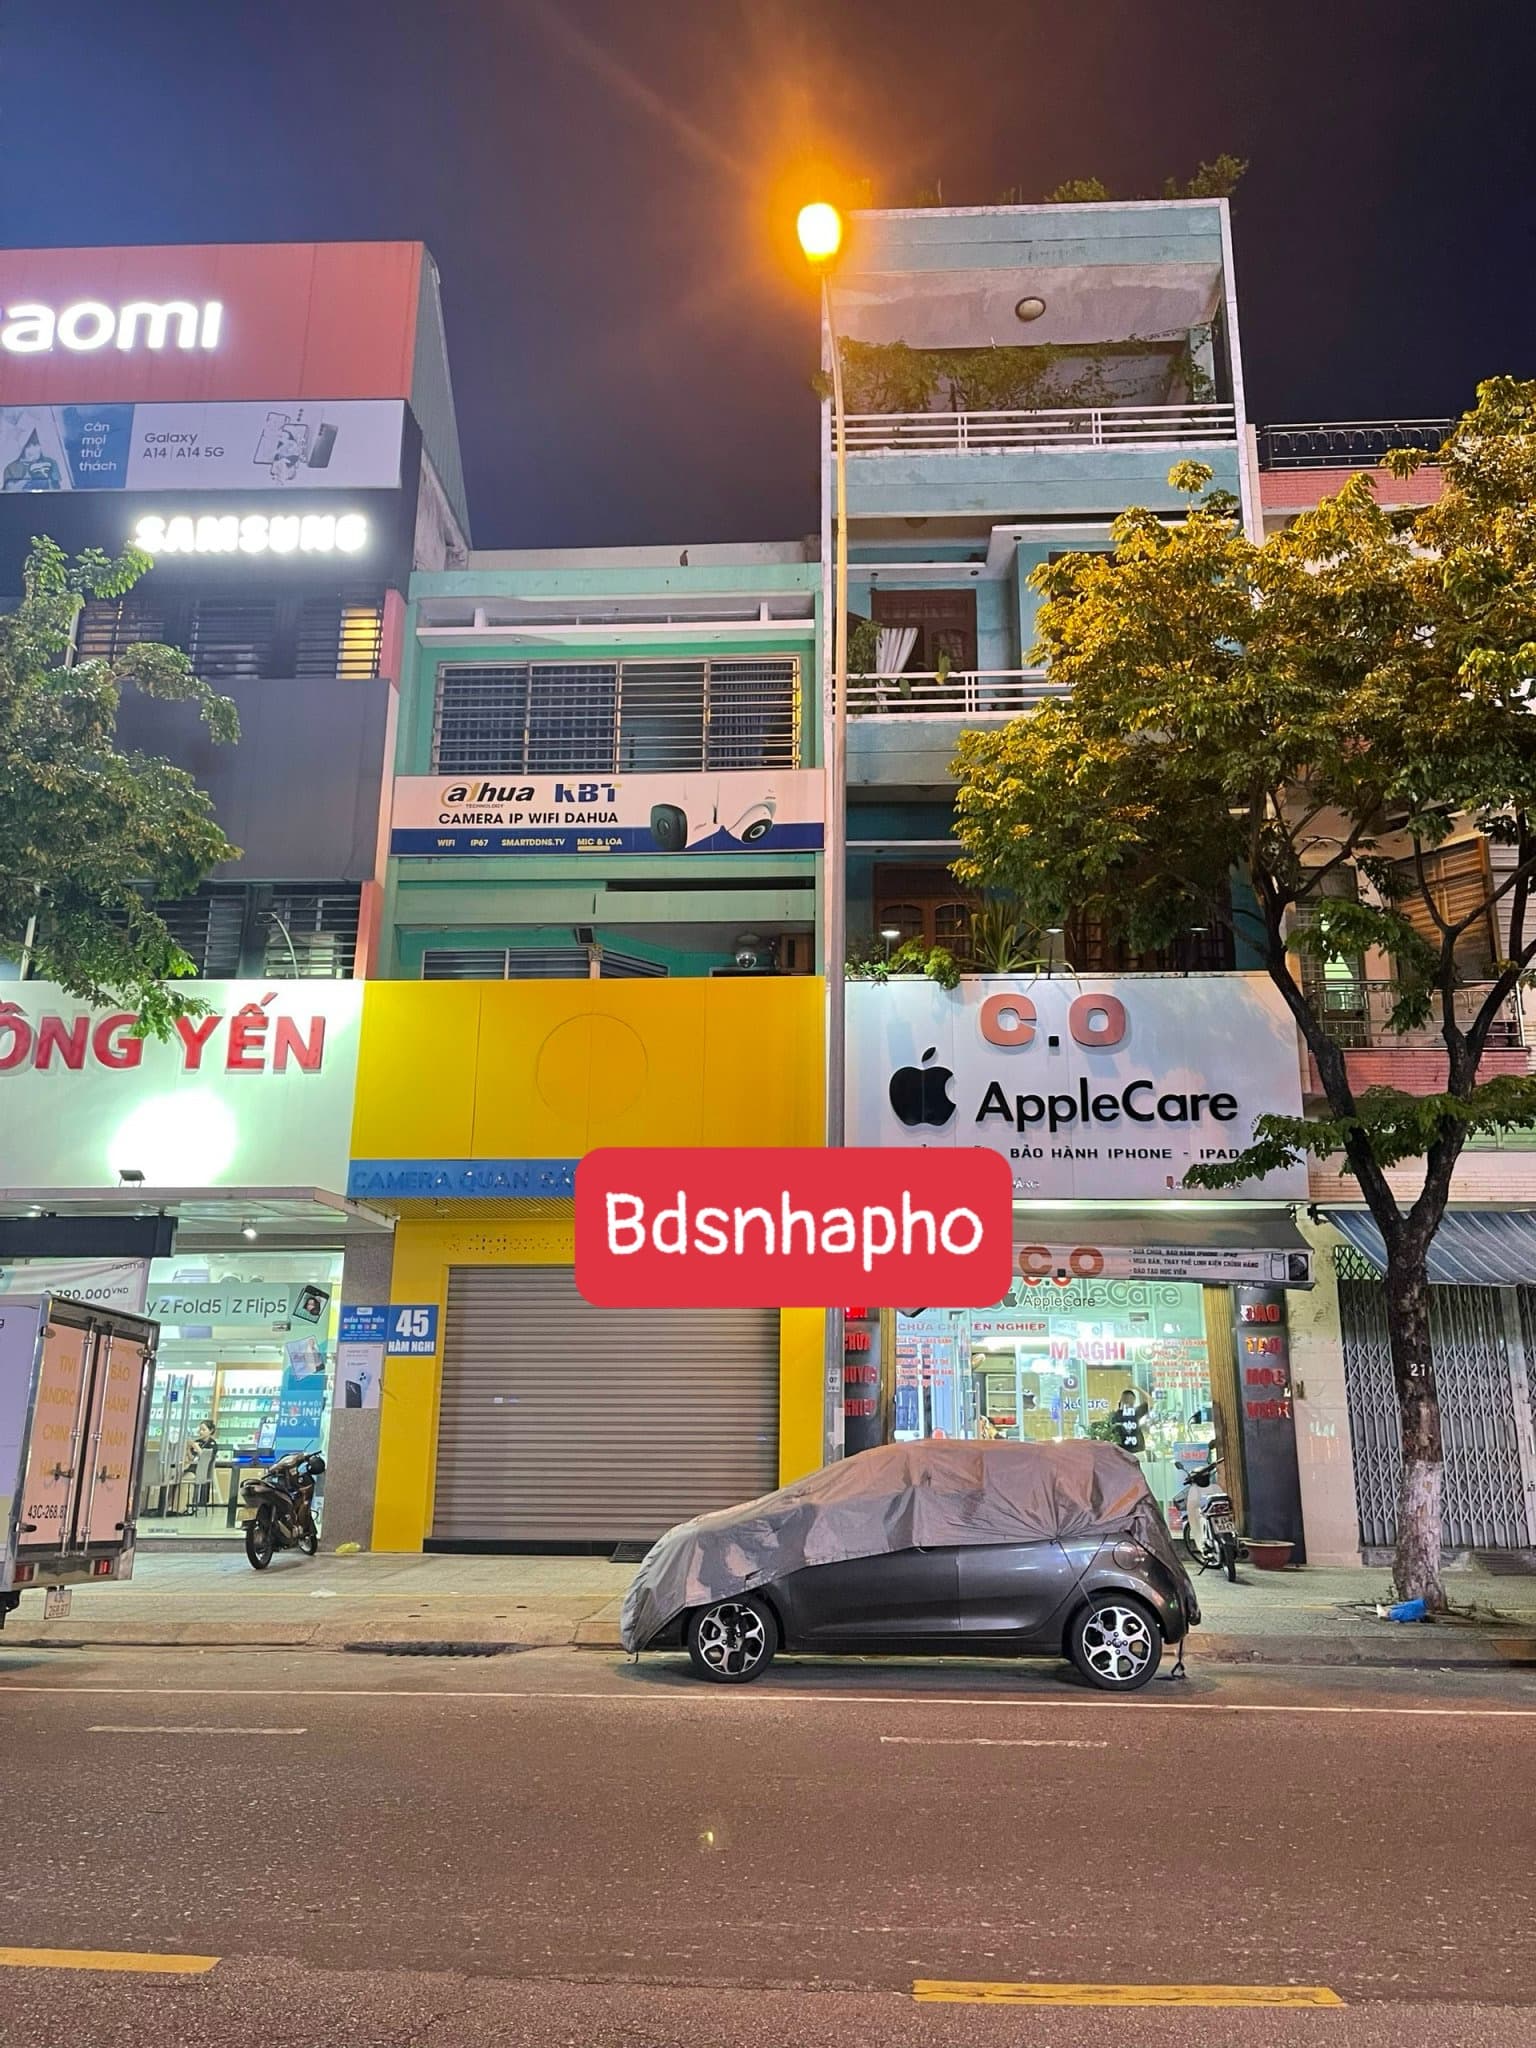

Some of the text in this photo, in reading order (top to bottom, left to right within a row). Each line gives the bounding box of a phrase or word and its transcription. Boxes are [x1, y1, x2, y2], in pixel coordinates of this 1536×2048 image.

[144, 432, 198, 444] Galaxy
[142, 446, 225, 459] A14 A14 5G
[135, 514, 367, 552] SAMSUNG
[438, 812, 618, 825] CAMERA IP WIFI DAHUA
[437, 839, 456, 847] WIFI
[470, 839, 489, 847] IP67
[577, 838, 594, 846] MIC
[173, 991, 326, 1070] YẾN
[975, 1077, 1238, 1133] AppleCare
[1010, 1143, 1043, 1159] BẢO
[1051, 1144, 1099, 1159] HÀNH
[1107, 1147, 1173, 1159] IPHONE
[1199, 1147, 1240, 1159] IPAD
[353, 1171, 452, 1189] CAMERA
[460, 1171, 528, 1192] QUAN
[160, 1300, 170, 1312] Z
[173, 1299, 221, 1313] Fold5
[232, 1299, 242, 1312] Z
[246, 1298, 287, 1318] Flip5
[395, 1309, 429, 1337] 45
[411, 1341, 435, 1353] NGHI
[1410, 1363, 1426, 1377] 21
